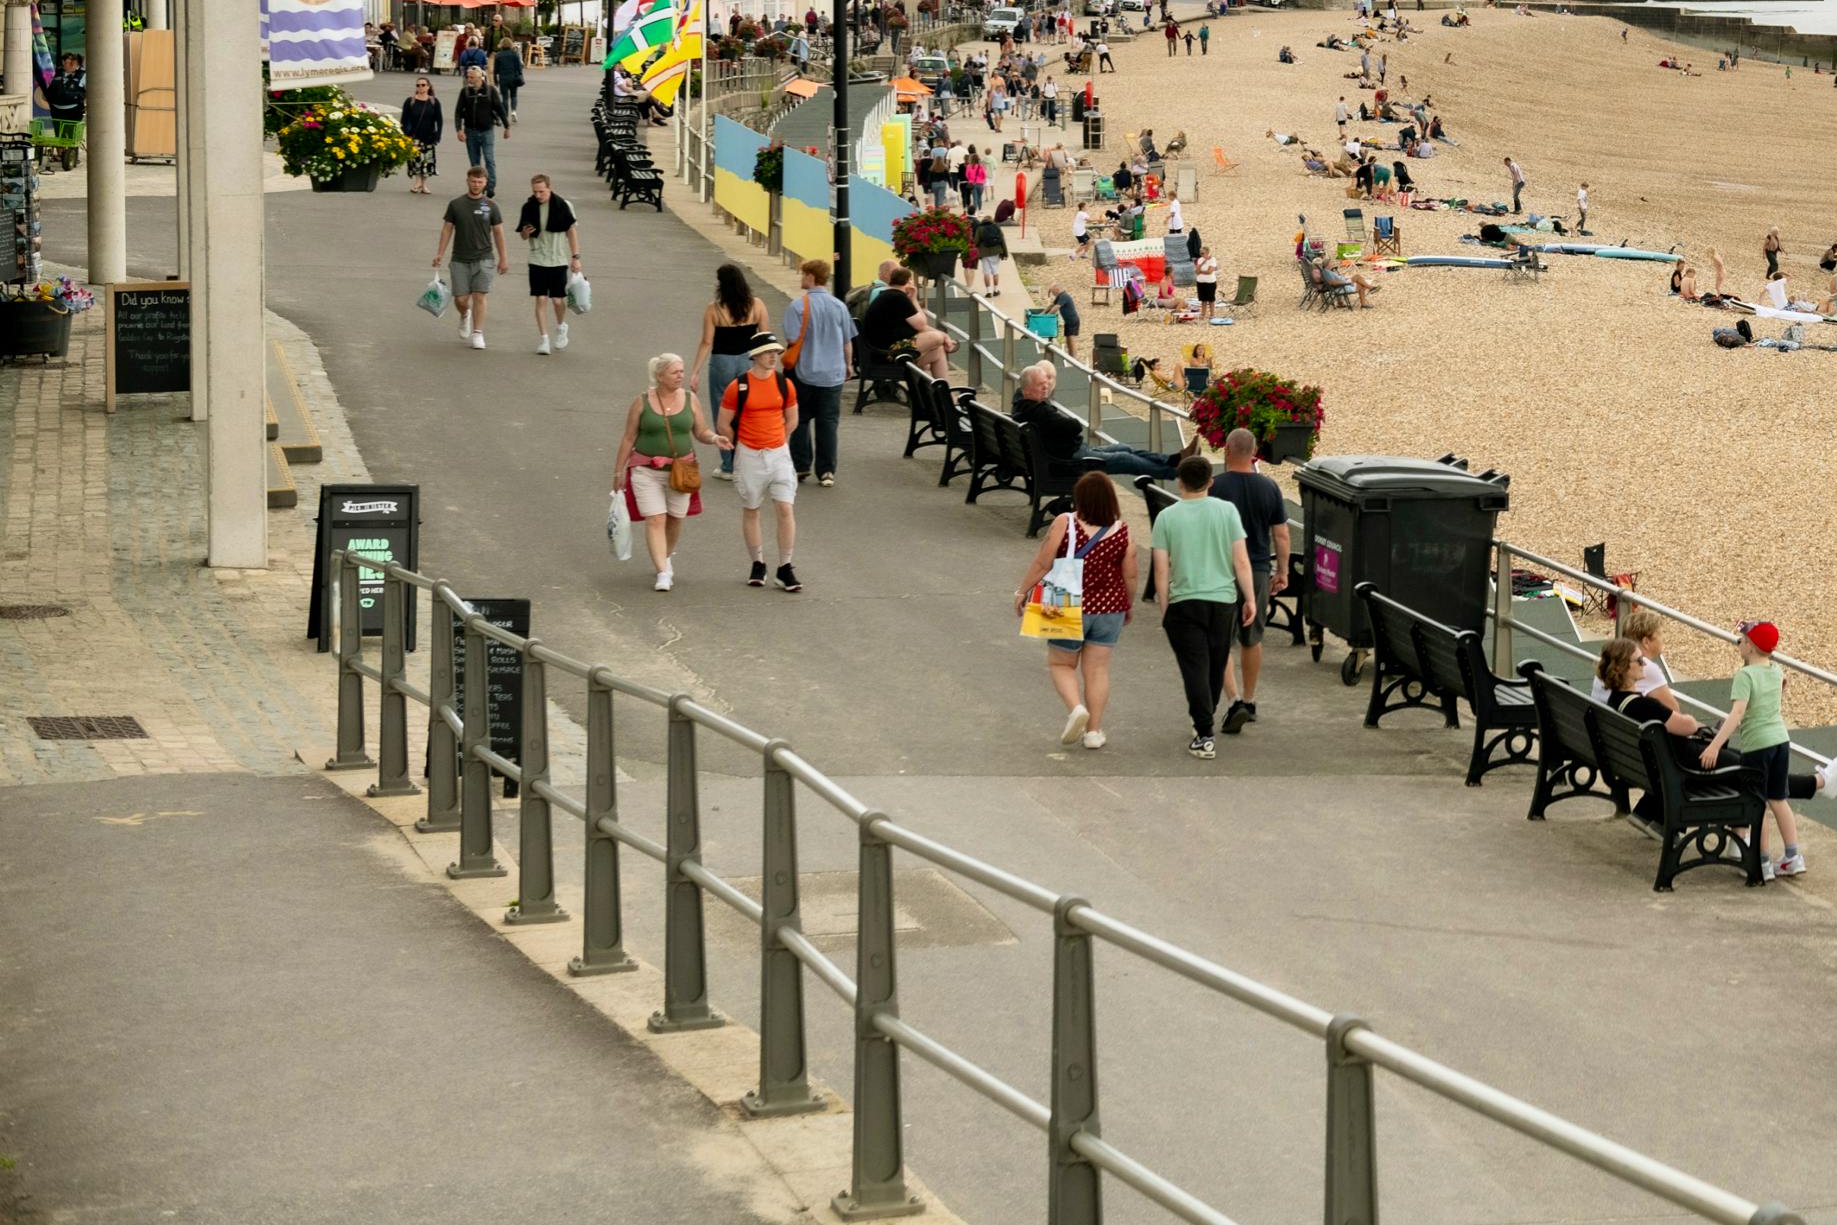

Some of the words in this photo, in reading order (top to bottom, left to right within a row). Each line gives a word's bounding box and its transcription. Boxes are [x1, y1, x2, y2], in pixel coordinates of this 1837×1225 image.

[121, 292, 138, 306] Did
[140, 296, 159, 309] you
[348, 538, 389, 550] AWARD
[358, 566, 385, 580] IES
